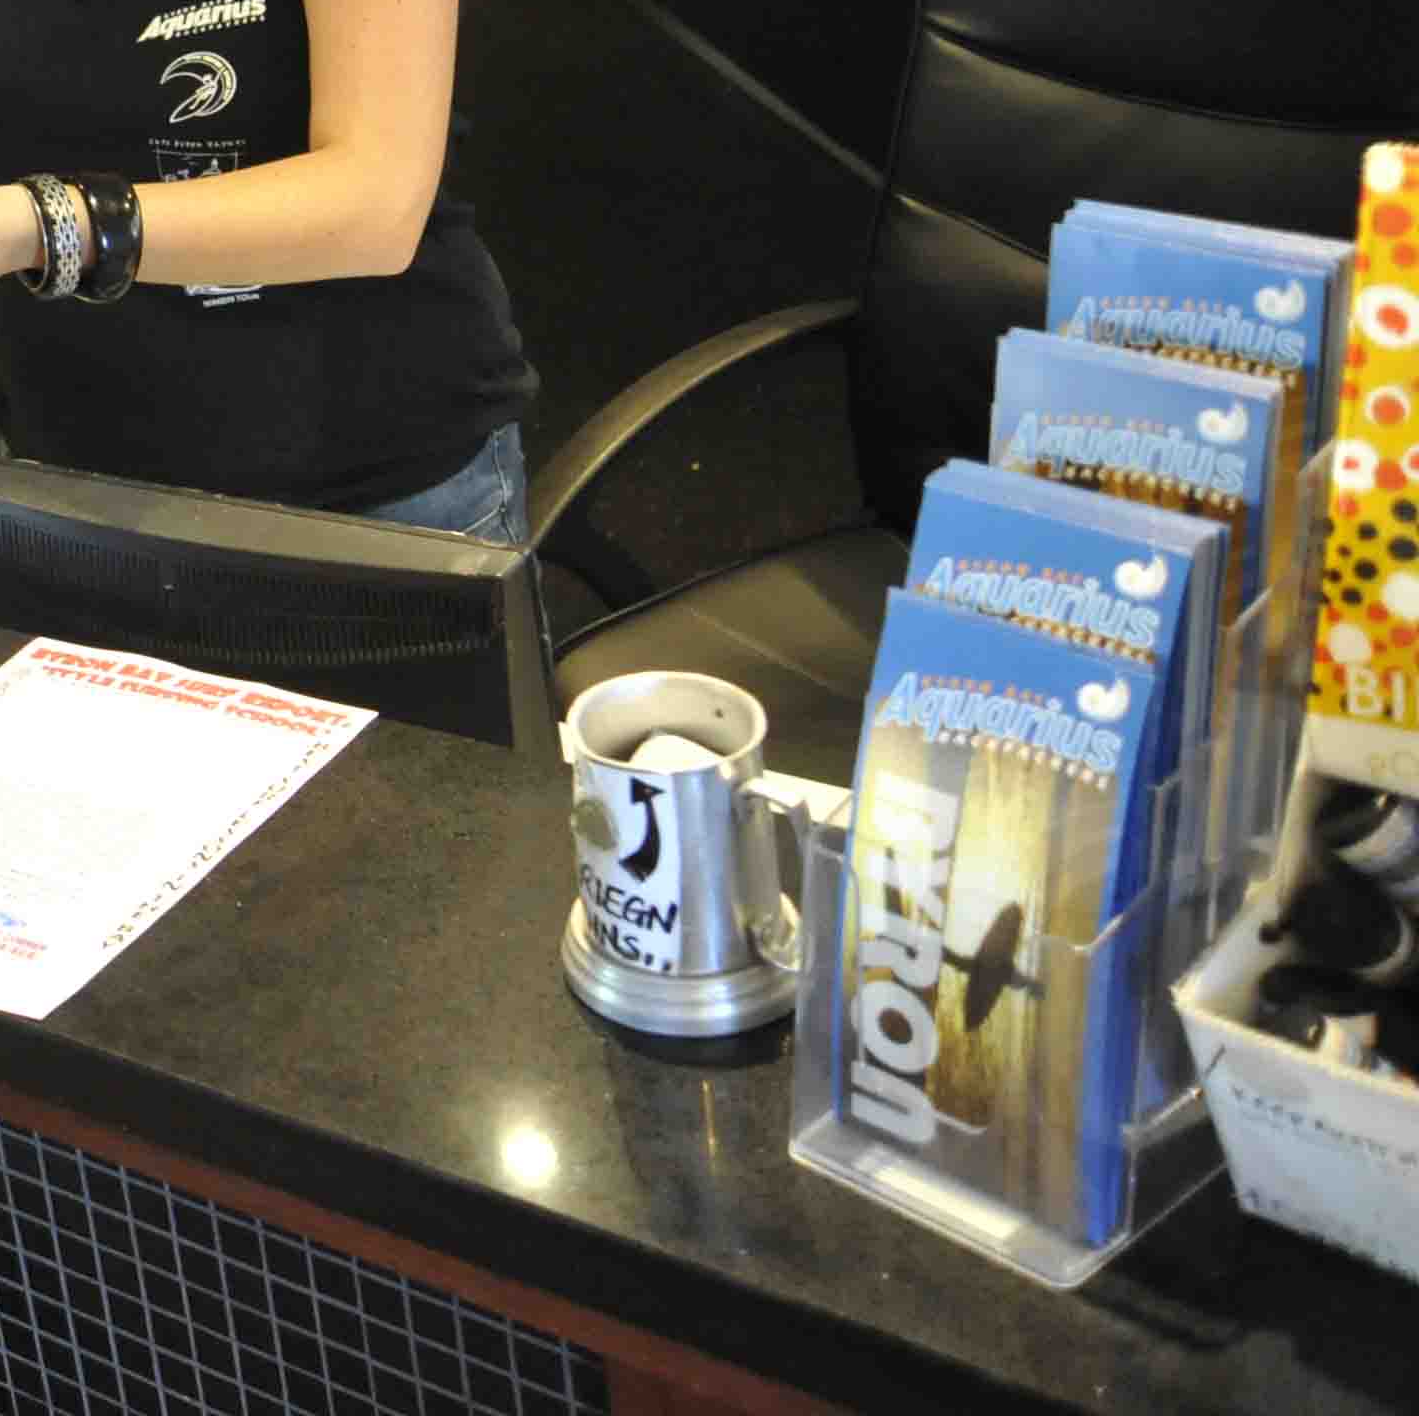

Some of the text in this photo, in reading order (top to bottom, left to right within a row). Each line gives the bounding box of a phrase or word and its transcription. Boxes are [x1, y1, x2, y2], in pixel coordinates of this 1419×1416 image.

[1004, 410, 1245, 495] Aquarius
[921, 555, 1162, 647] Aquarius
[873, 671, 1123, 774] Aquarius
[1346, 665, 1419, 722] BI
